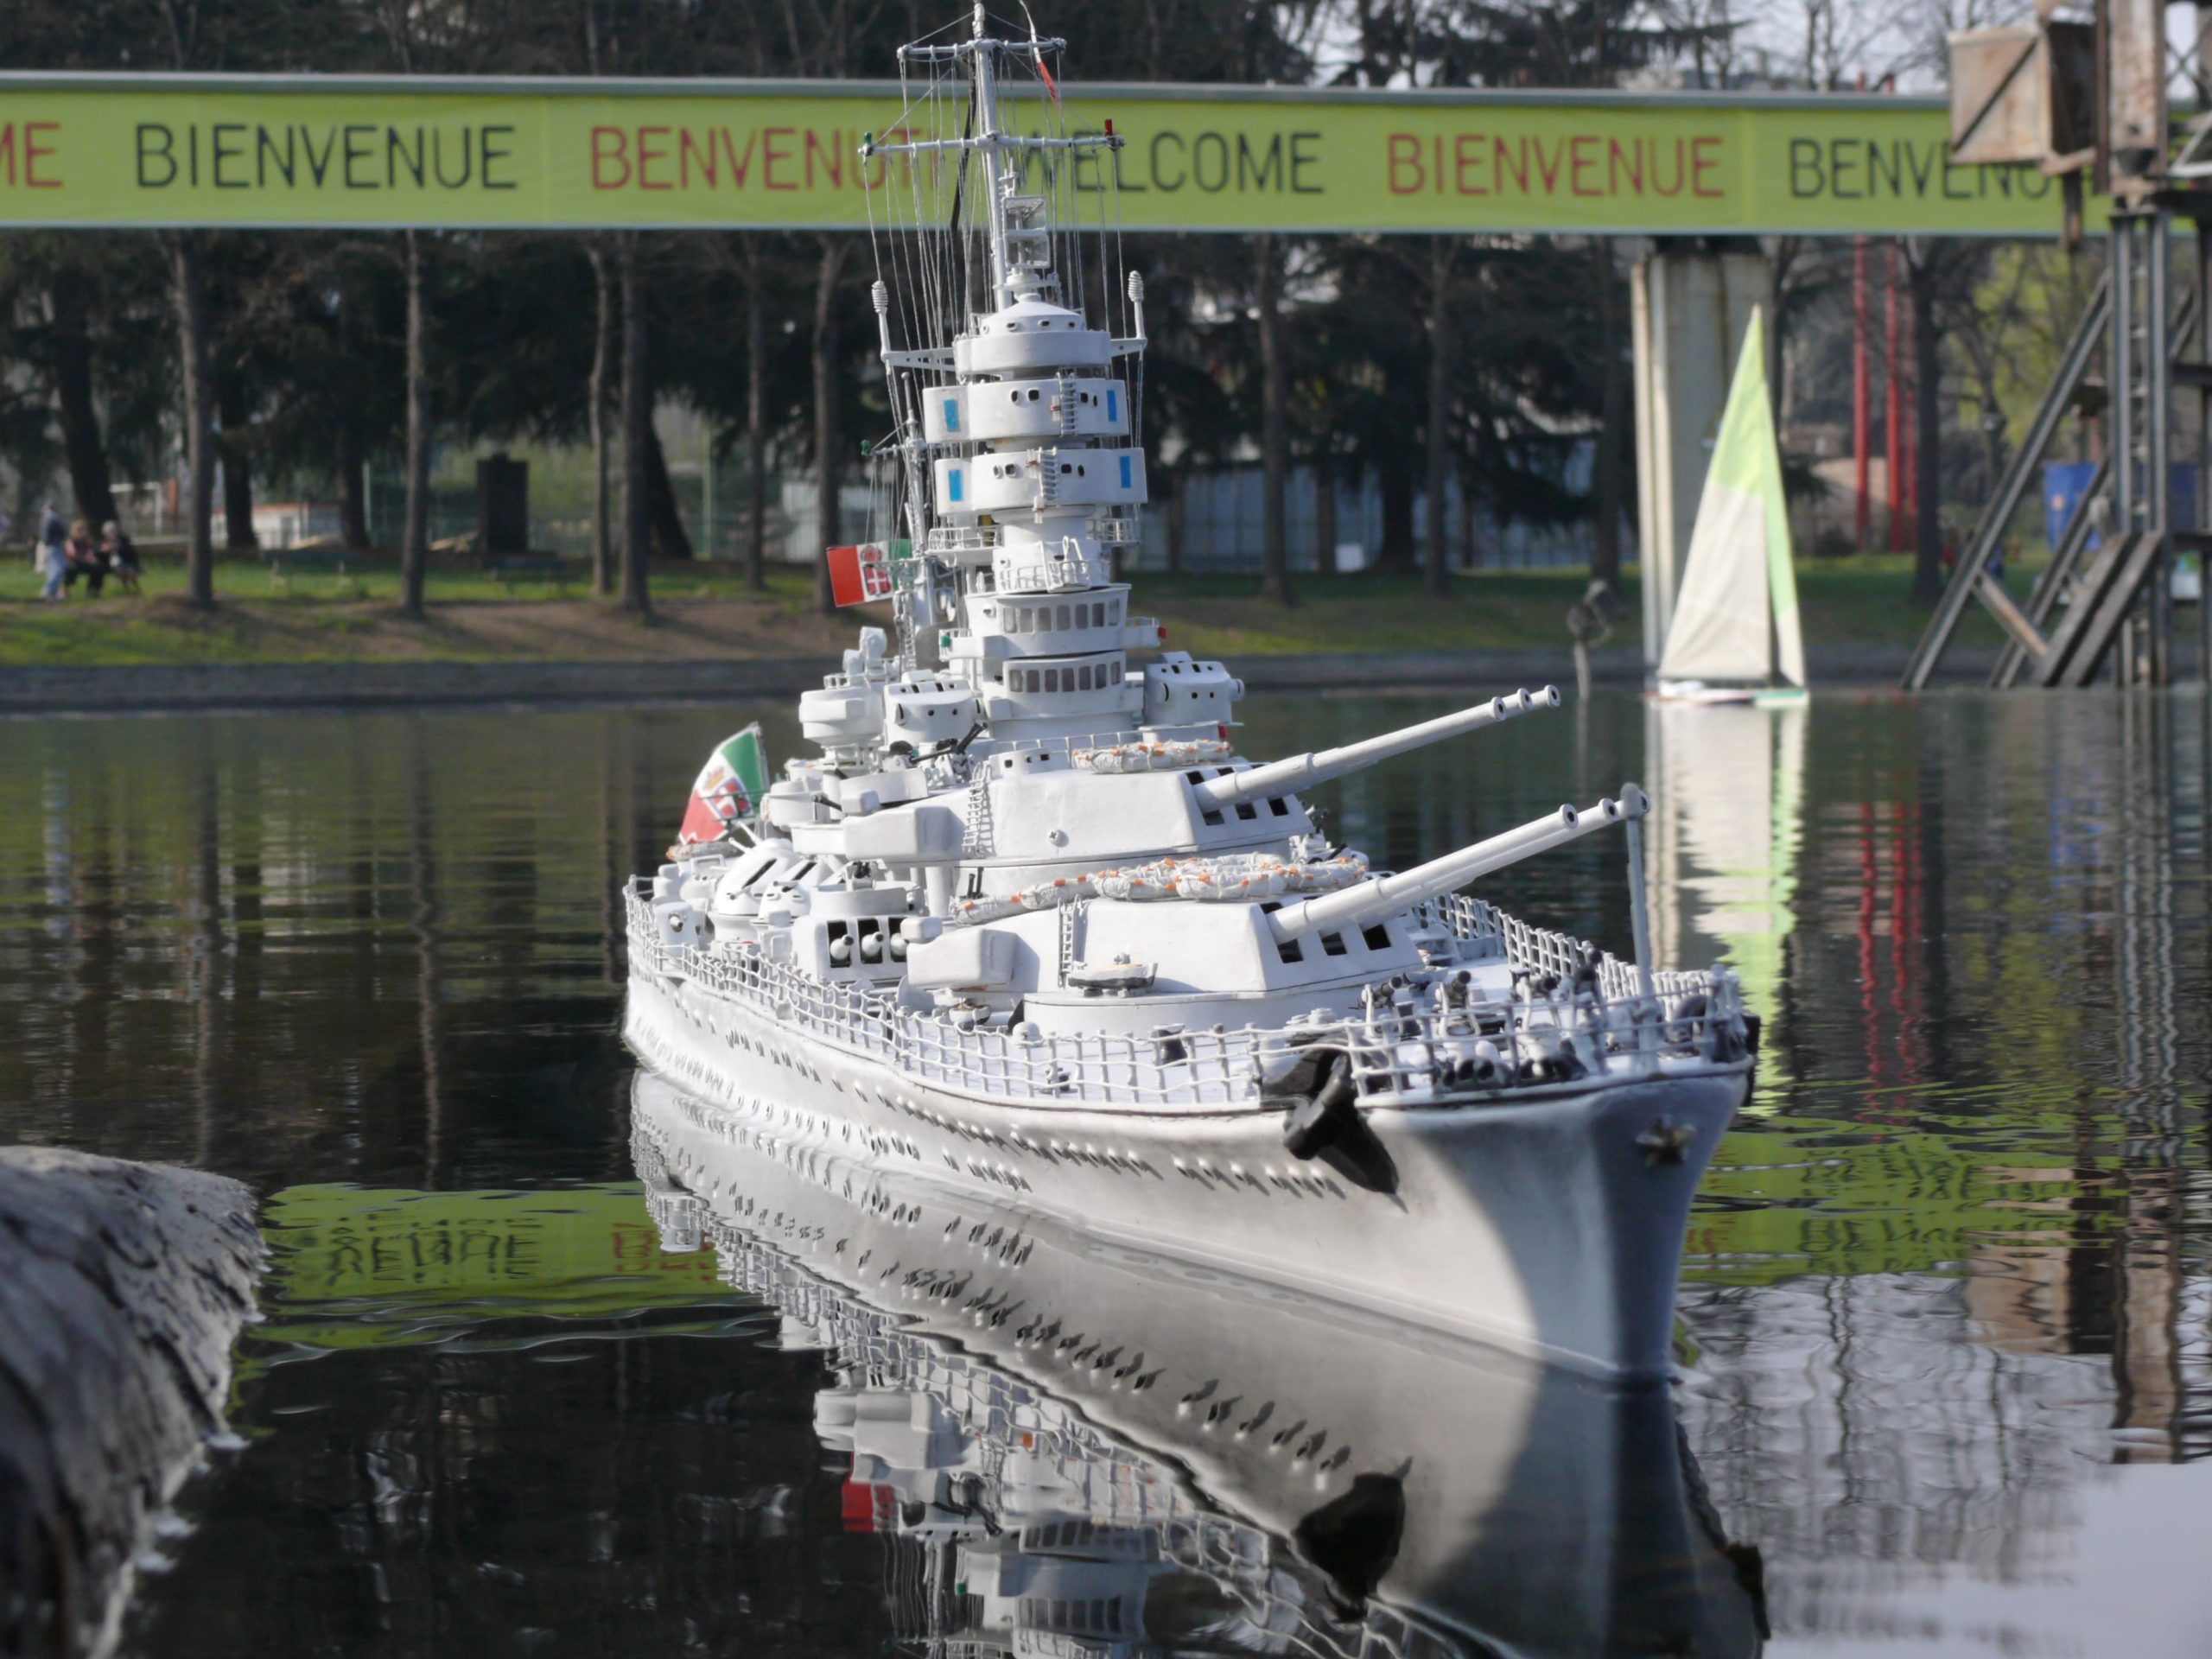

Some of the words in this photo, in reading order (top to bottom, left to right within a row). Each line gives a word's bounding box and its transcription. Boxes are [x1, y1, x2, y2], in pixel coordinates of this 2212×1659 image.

[136, 123, 517, 188] BIENVENUE
[1007, 130, 1323, 194] WELCOME
[1389, 133, 1724, 197] BIENVENUE
[1789, 137, 2053, 199] BENVENU
